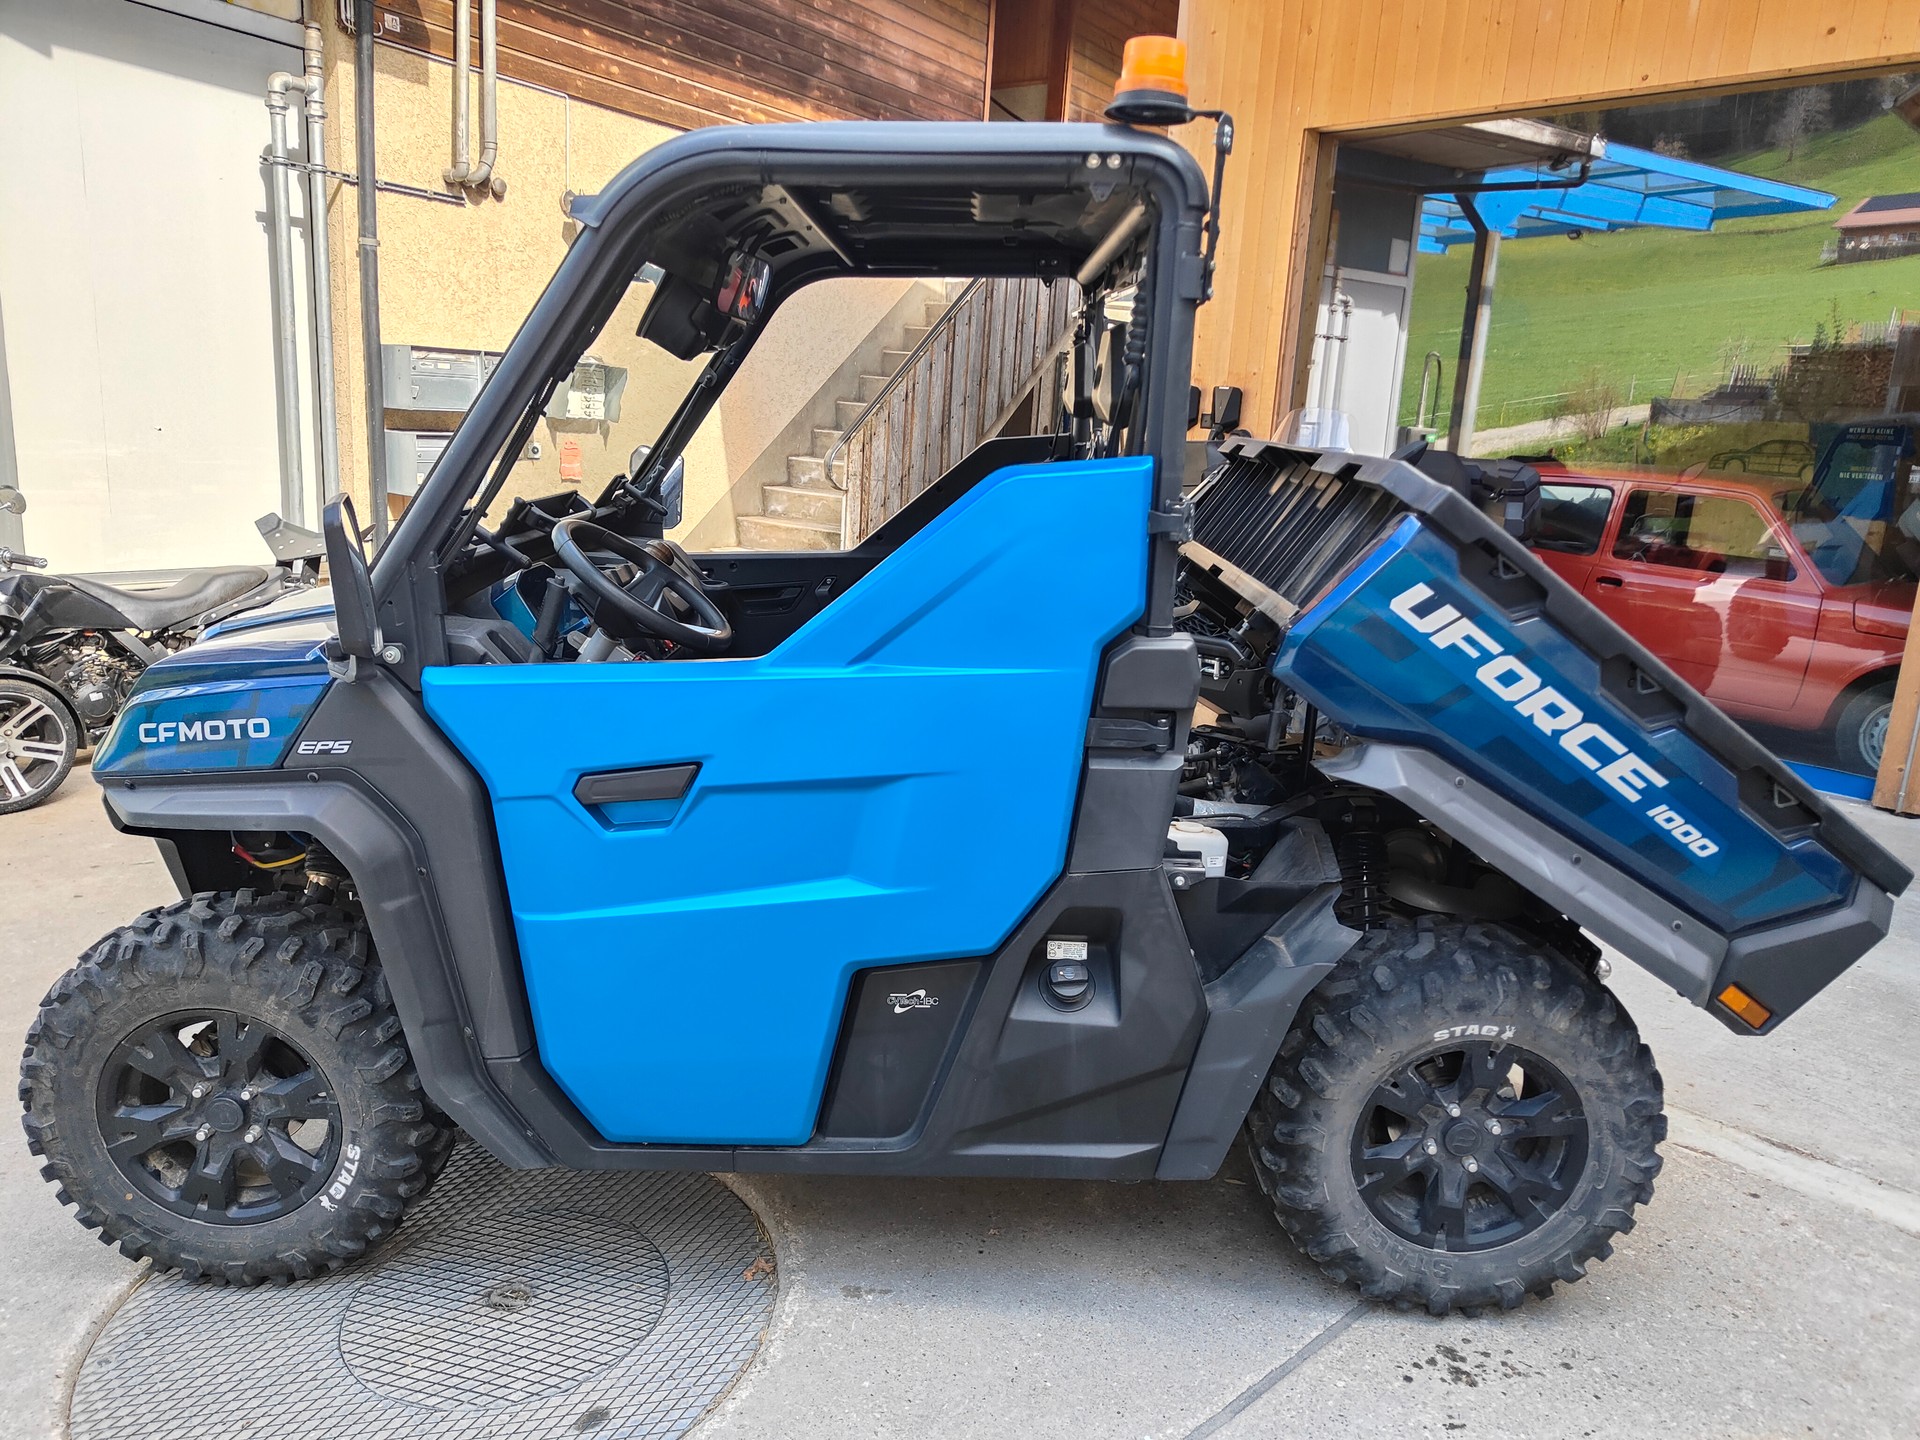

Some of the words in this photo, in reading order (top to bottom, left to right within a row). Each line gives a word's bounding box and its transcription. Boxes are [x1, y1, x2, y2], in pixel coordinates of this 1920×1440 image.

[138, 717, 271, 743] CFMOTO
[1389, 582, 1669, 803] UFORCE
[1645, 804, 1720, 857] 1000
[297, 740, 352, 755] EPS
[328, 1143, 361, 1200] STAG
